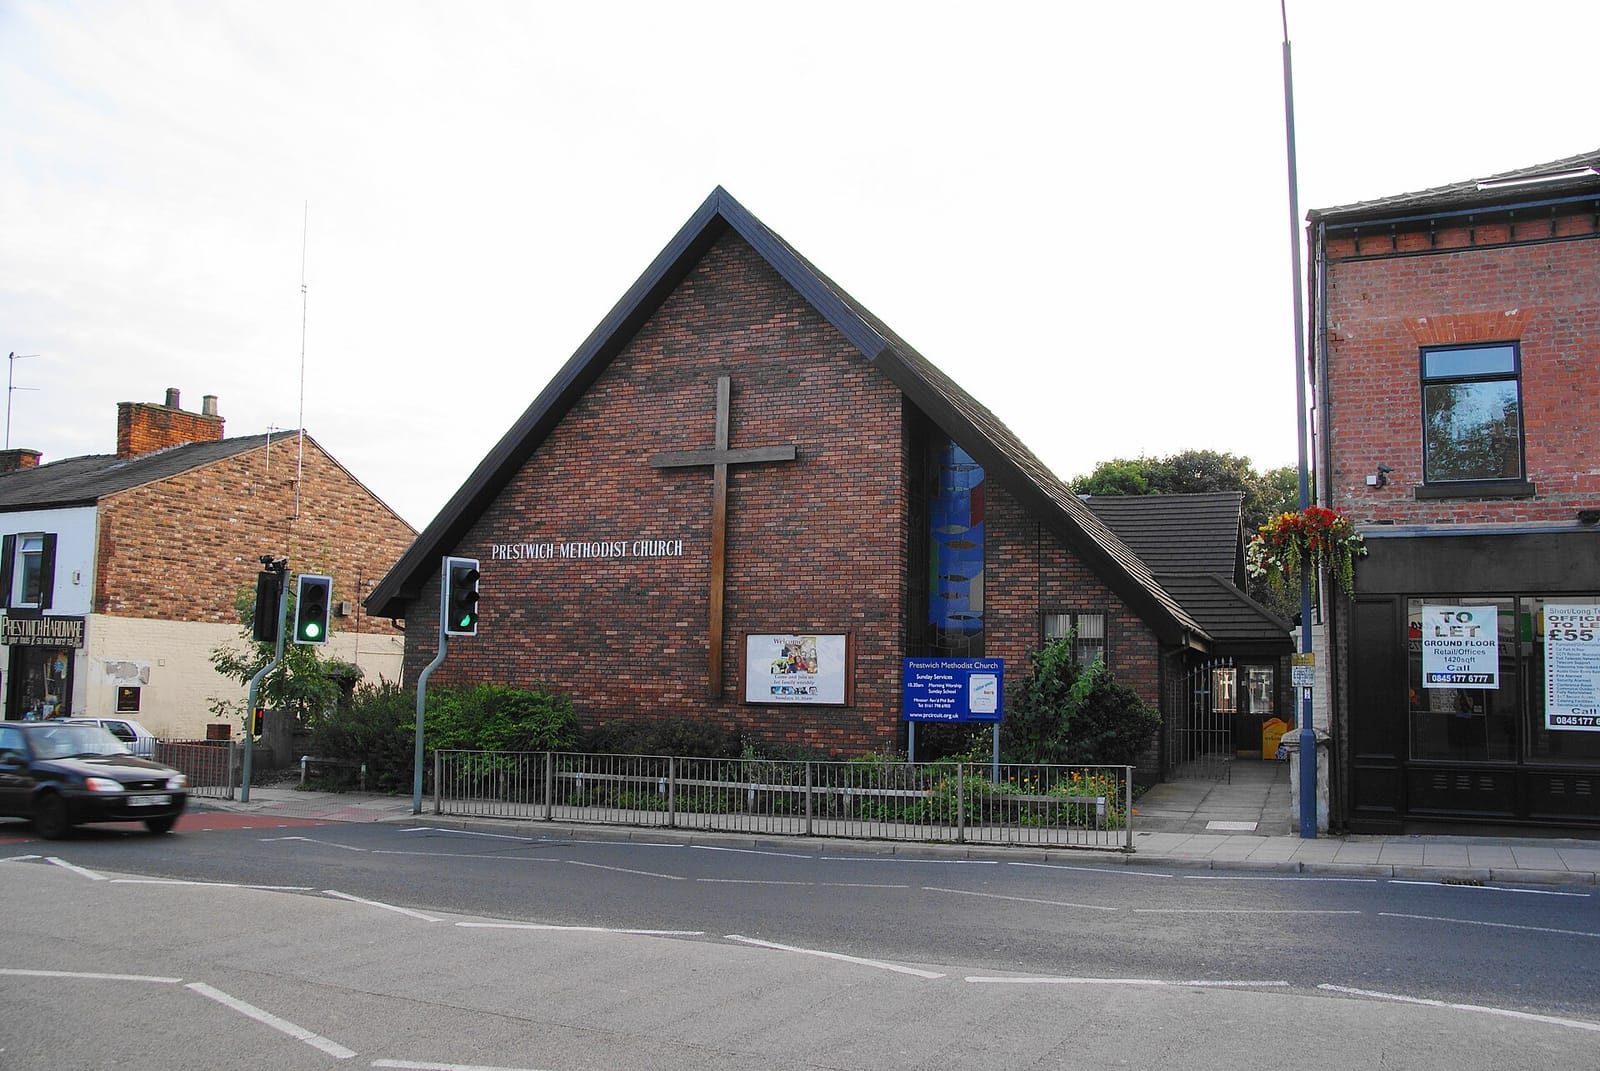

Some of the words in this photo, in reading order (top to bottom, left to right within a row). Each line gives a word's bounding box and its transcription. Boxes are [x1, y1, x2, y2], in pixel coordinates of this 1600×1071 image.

[491, 543, 554, 559] PRESTWICH
[560, 542, 627, 558] METHODIST
[633, 540, 682, 556] CHURCH
[1440, 612, 1473, 624] TO
[1435, 625, 1481, 638] LET
[909, 661, 939, 669] Prestwich
[974, 661, 998, 669] Church
[1468, 674, 1489, 683] 6777
